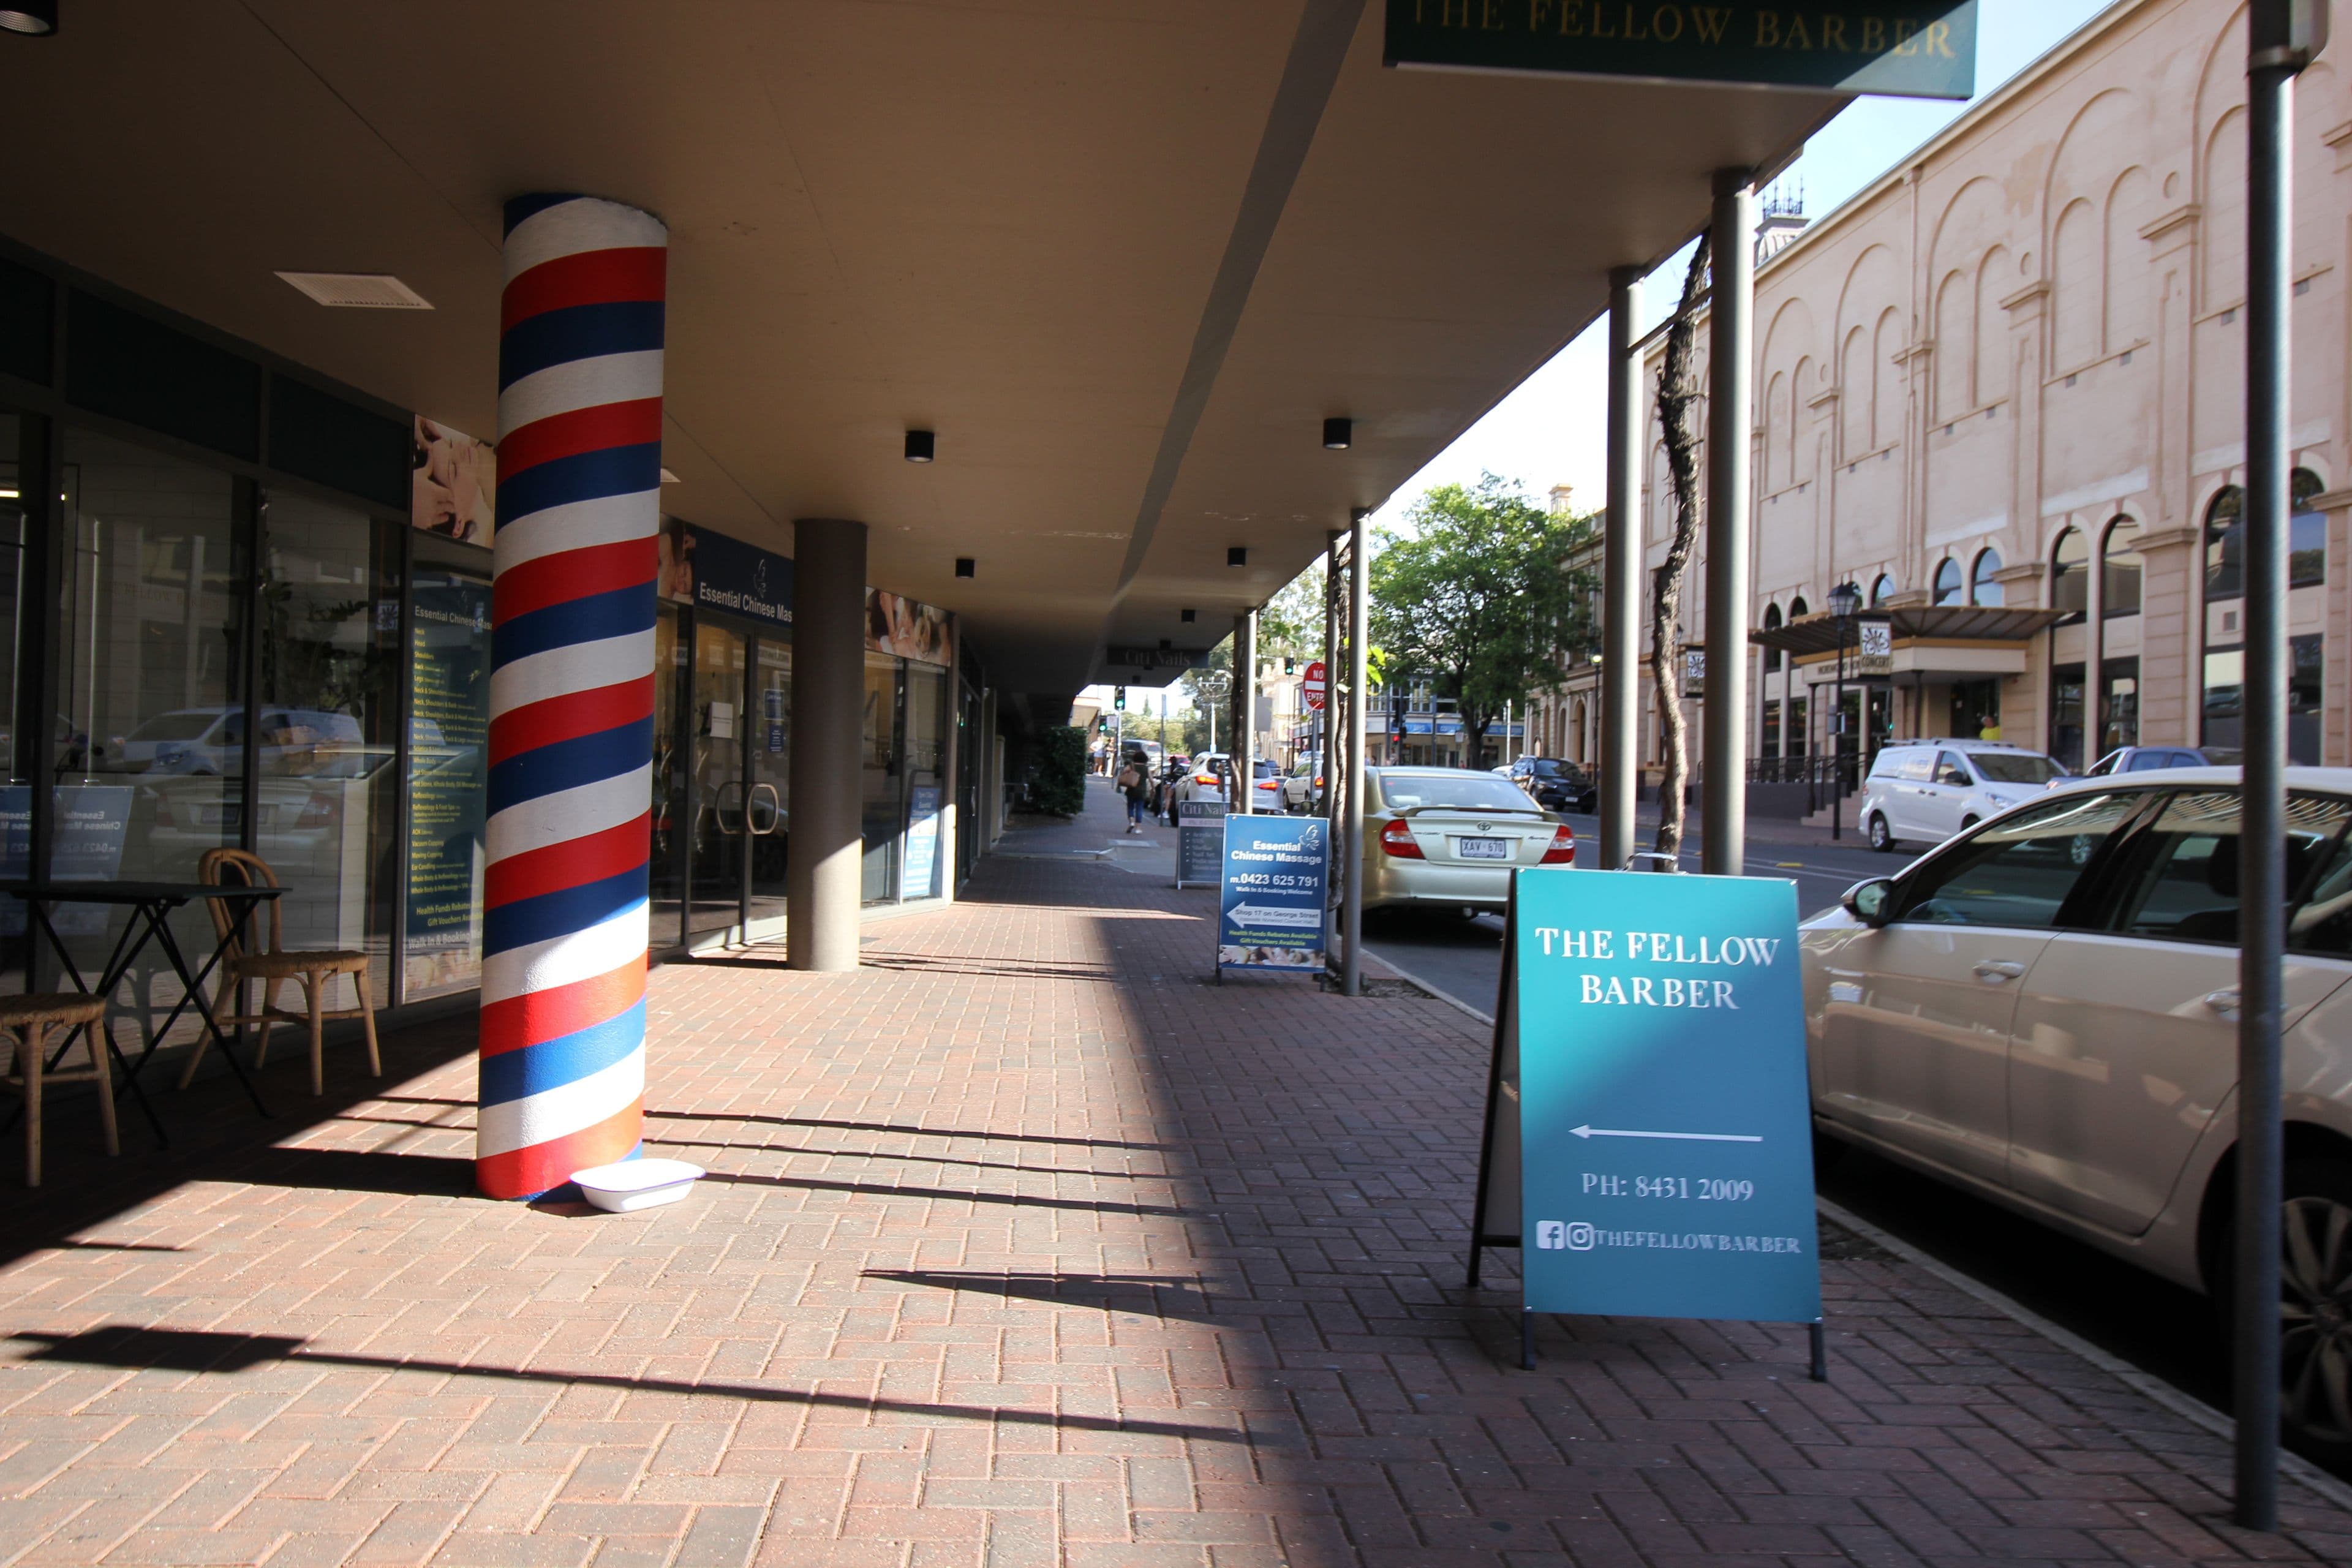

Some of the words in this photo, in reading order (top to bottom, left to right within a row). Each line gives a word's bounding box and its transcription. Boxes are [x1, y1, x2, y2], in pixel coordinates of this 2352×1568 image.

[1413, 0, 1505, 31] THE
[1529, 0, 1733, 45] FELLOW
[1754, 10, 1956, 59] BARBER
[699, 581, 741, 608] Essential
[742, 594, 775, 618] Chinese
[415, 605, 448, 622] Essential
[450, 612, 476, 627] Chinese
[1125, 649, 1151, 665] Citi
[1156, 650, 1191, 666] Nails
[1313, 669, 1324, 680] NO
[1306, 692, 1324, 702] ENTR
[1182, 804, 1200, 814] Citi
[1253, 840, 1302, 852] Essential
[1231, 850, 1274, 861] Chinese
[1276, 853, 1322, 865] Massage
[1230, 873, 1270, 884] m.0423
[1272, 875, 1295, 886] 625
[1298, 876, 1318, 887] 791
[417, 905, 434, 915] Health
[435, 903, 451, 913] Funds
[427, 918, 437, 927] Gift
[439, 916, 461, 925] Vouchers
[409, 935, 427, 949] Walk
[1535, 927, 1614, 959] THE
[1626, 931, 1781, 967] FELLOW
[1579, 974, 1740, 1009] BARBER
[1581, 1172, 1627, 1196] PH:
[1635, 1175, 1691, 1199] 8431
[1697, 1178, 1754, 1200] 2009
[1594, 1229, 1803, 1254] THEFELLOWBARBER
